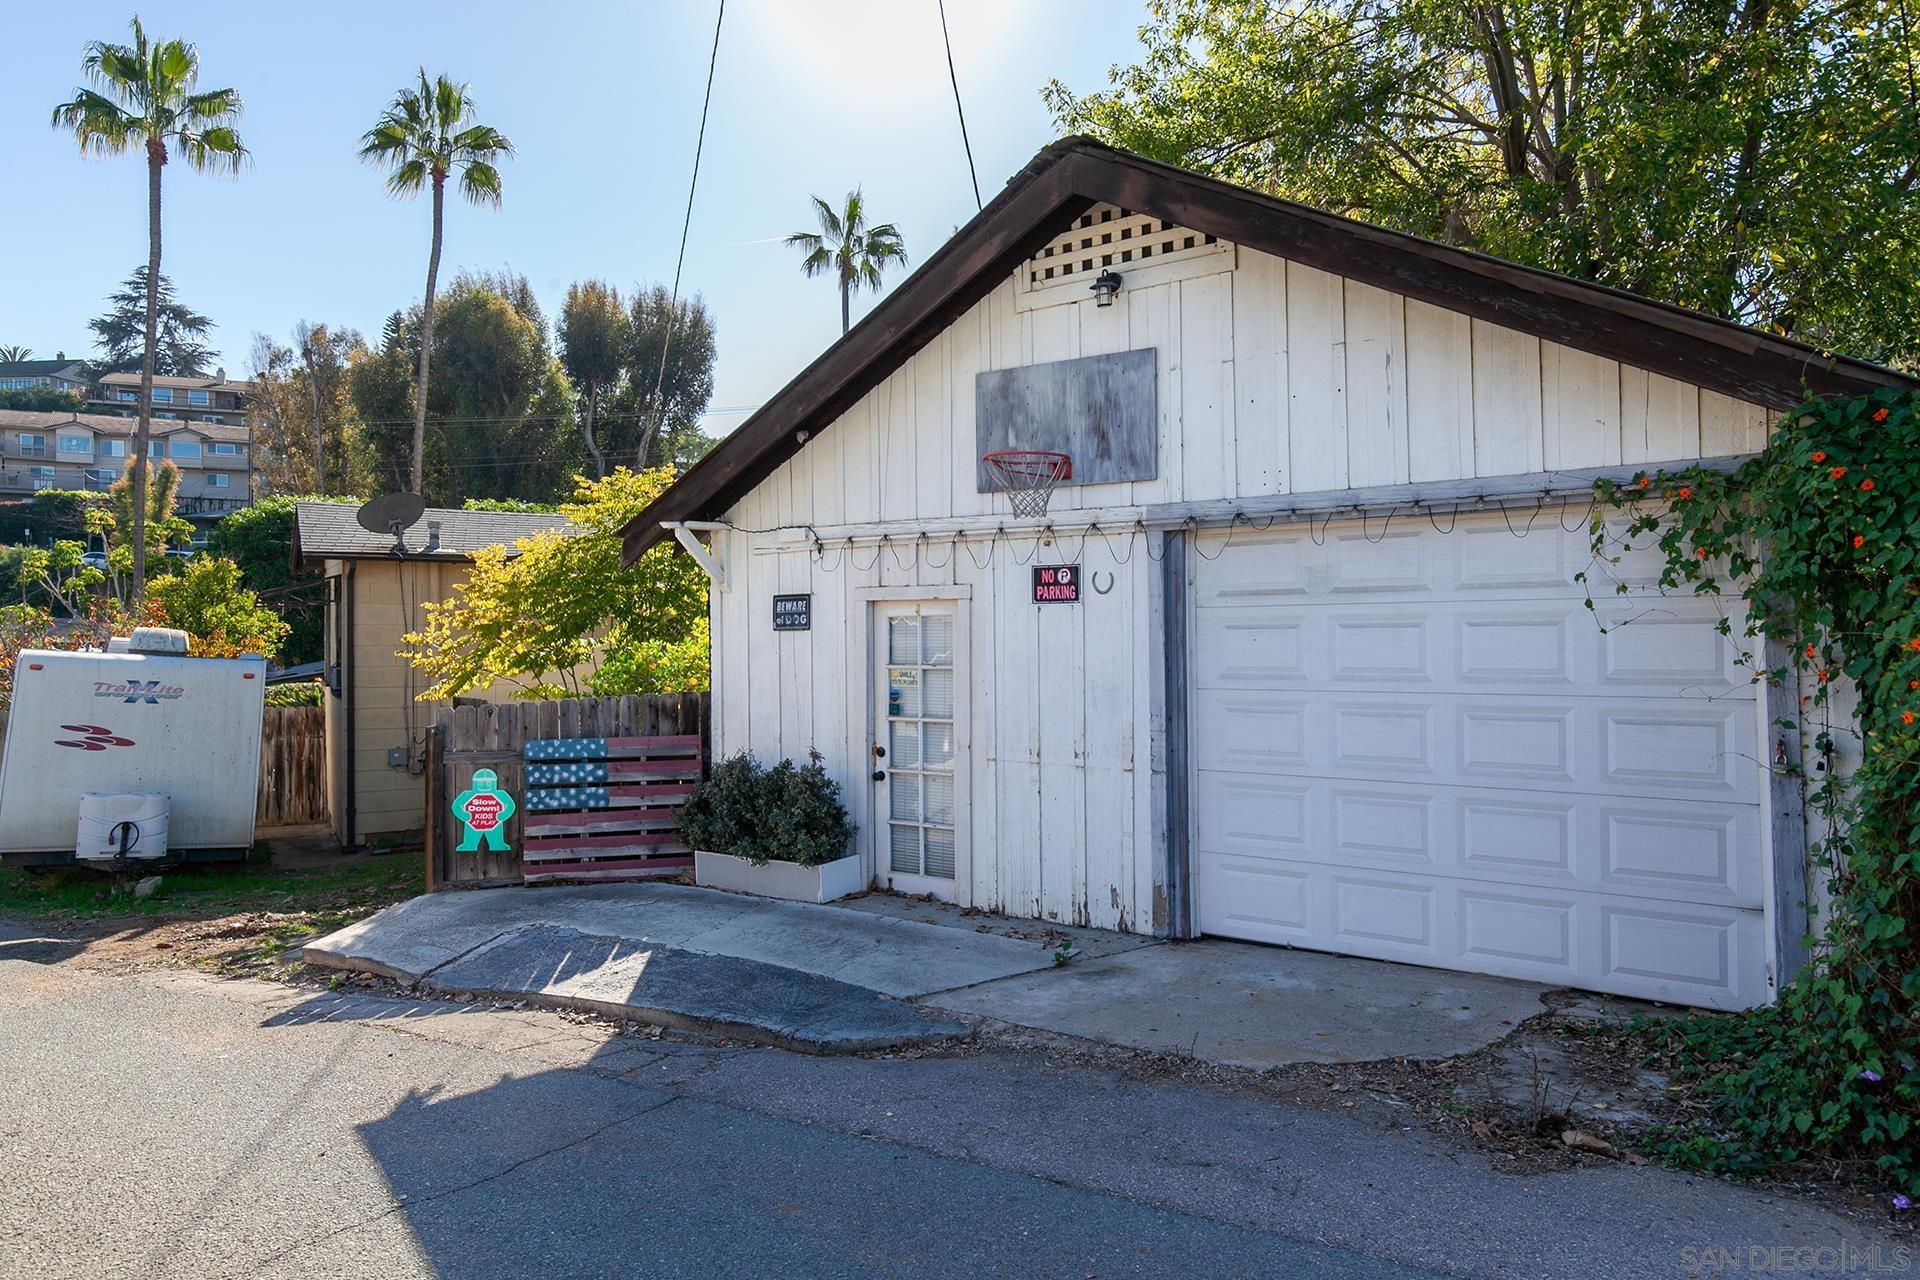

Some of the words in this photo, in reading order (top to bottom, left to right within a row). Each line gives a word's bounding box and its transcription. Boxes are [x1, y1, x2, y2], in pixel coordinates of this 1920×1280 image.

[1041, 569, 1055, 584] NO
[1036, 585, 1076, 600] PARKING
[776, 600, 807, 612] BEWARE
[784, 614, 807, 625] DOG
[474, 812, 494, 820] KIDS
